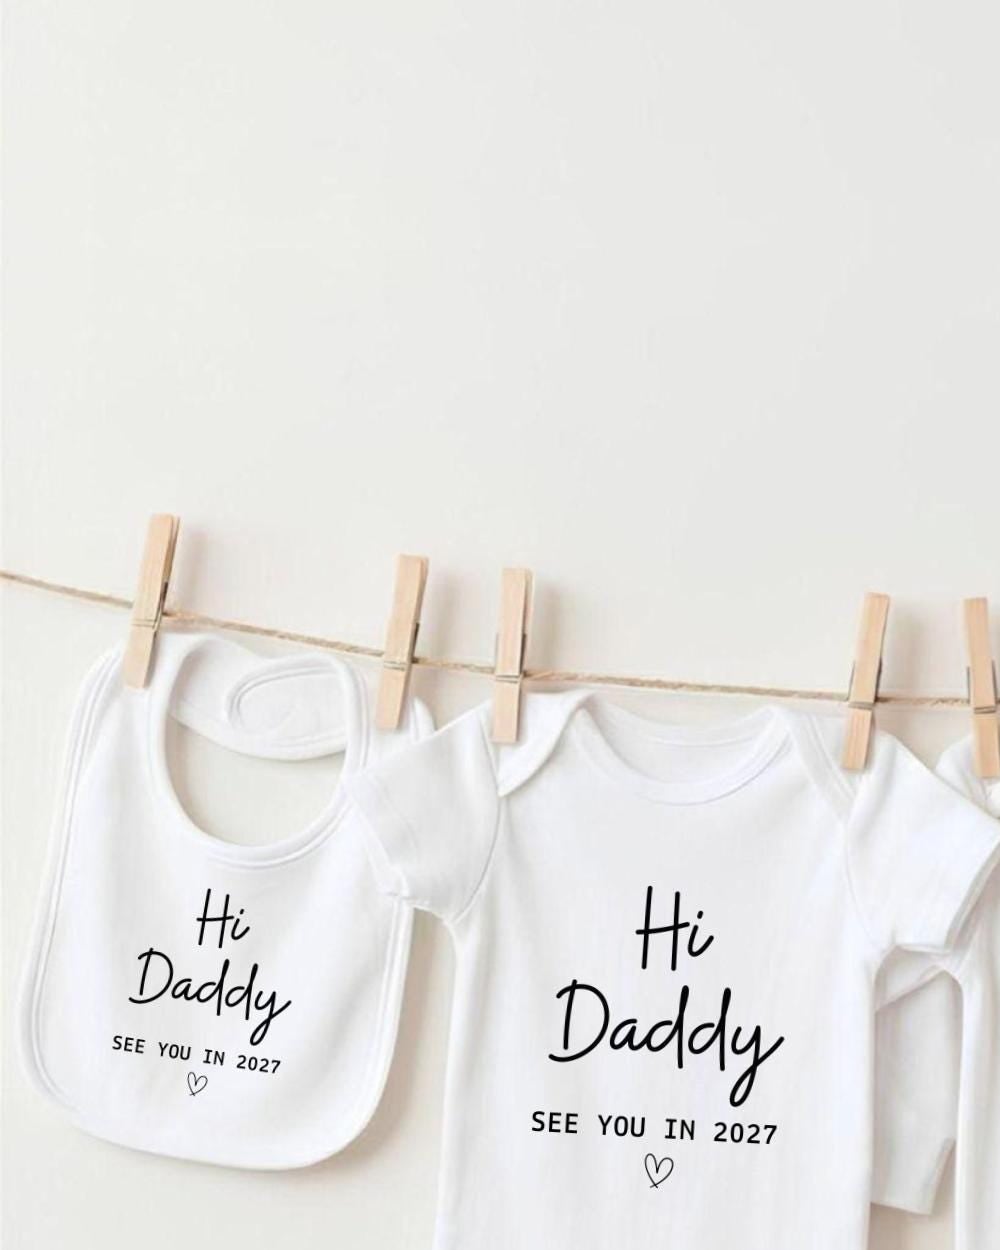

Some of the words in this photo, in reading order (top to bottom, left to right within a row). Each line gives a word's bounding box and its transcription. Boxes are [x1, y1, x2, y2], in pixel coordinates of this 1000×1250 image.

[196, 888, 251, 949] Hi
[635, 885, 715, 972] Hi
[128, 947, 292, 1047] Daddy
[112, 1035, 146, 1054] SEE
[158, 1041, 192, 1061] YOU
[202, 1048, 225, 1066] IN
[236, 1054, 282, 1074] 2027
[548, 978, 785, 1108] Daddy
[531, 1110, 579, 1134] SEE
[597, 1114, 646, 1138] YOU
[664, 1118, 695, 1141] IN
[713, 1121, 778, 1145] 2027
